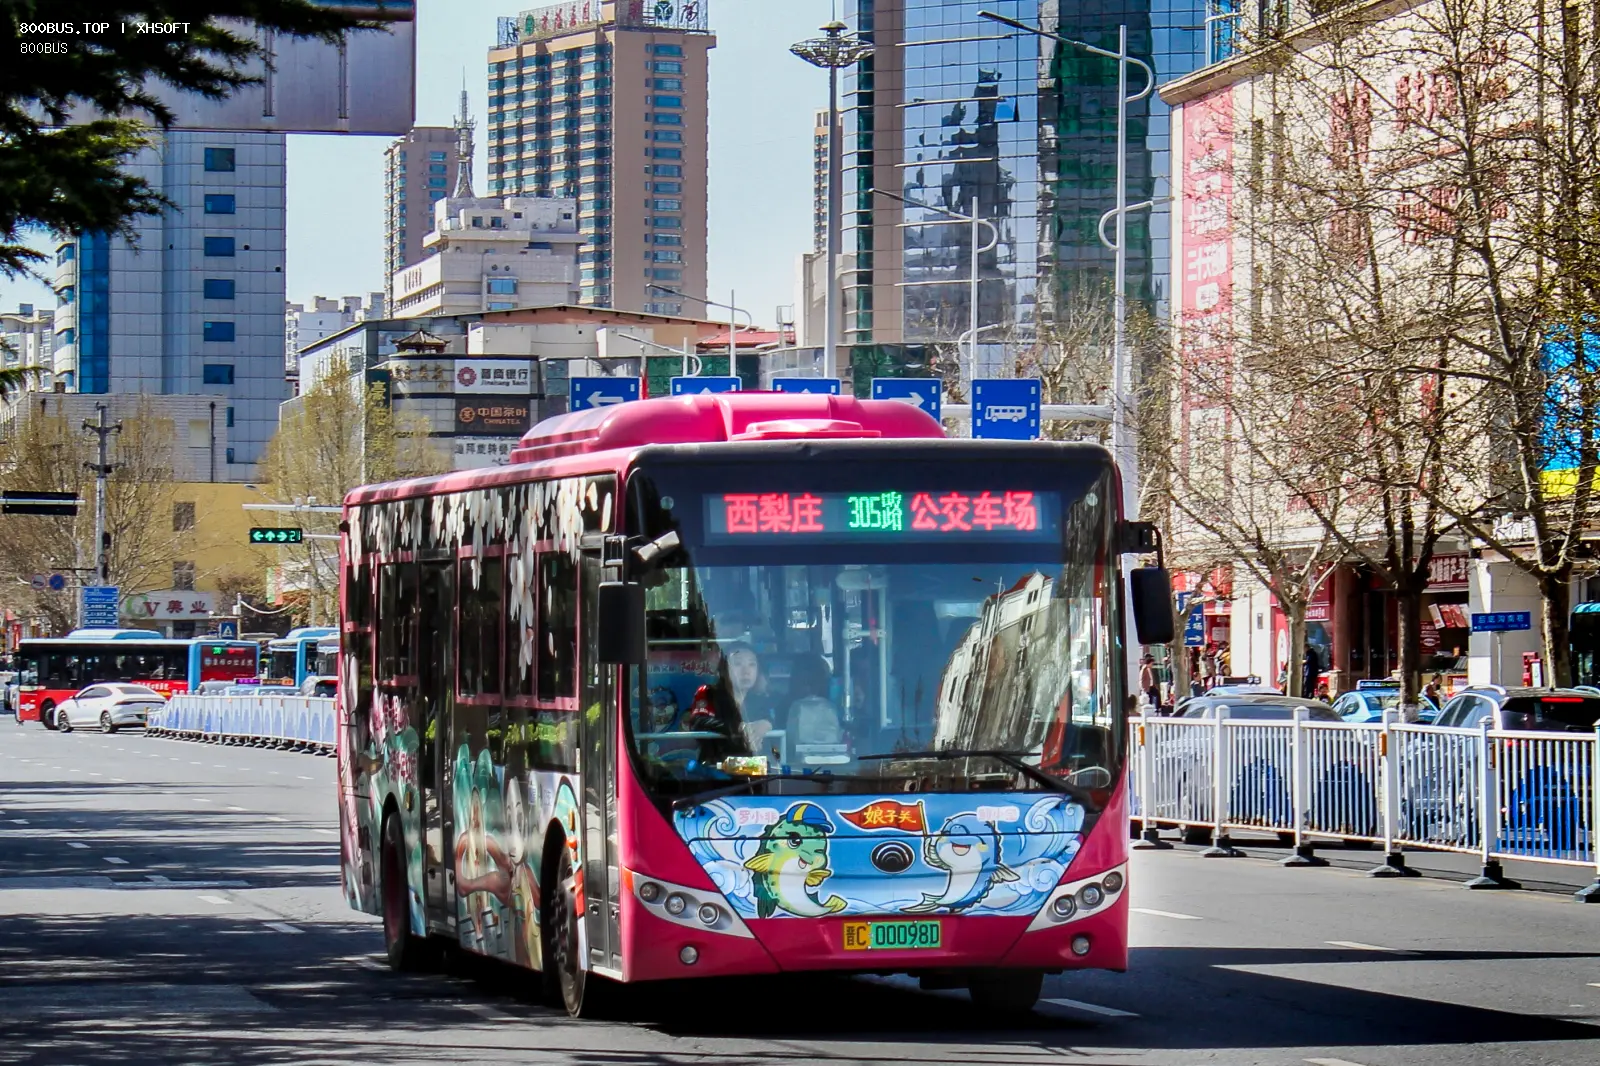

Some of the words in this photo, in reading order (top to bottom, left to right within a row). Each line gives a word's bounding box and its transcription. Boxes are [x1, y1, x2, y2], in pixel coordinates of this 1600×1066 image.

[481, 368, 529, 380] 晋商银行
[477, 407, 528, 417] 中国茶叶
[723, 493, 824, 533] 西梨庄
[847, 491, 903, 531] 305路
[910, 491, 1037, 532] 公交车场
[863, 806, 917, 826] 娘子关
[846, 925, 867, 946] 晋C
[875, 924, 940, 945] 00098D
